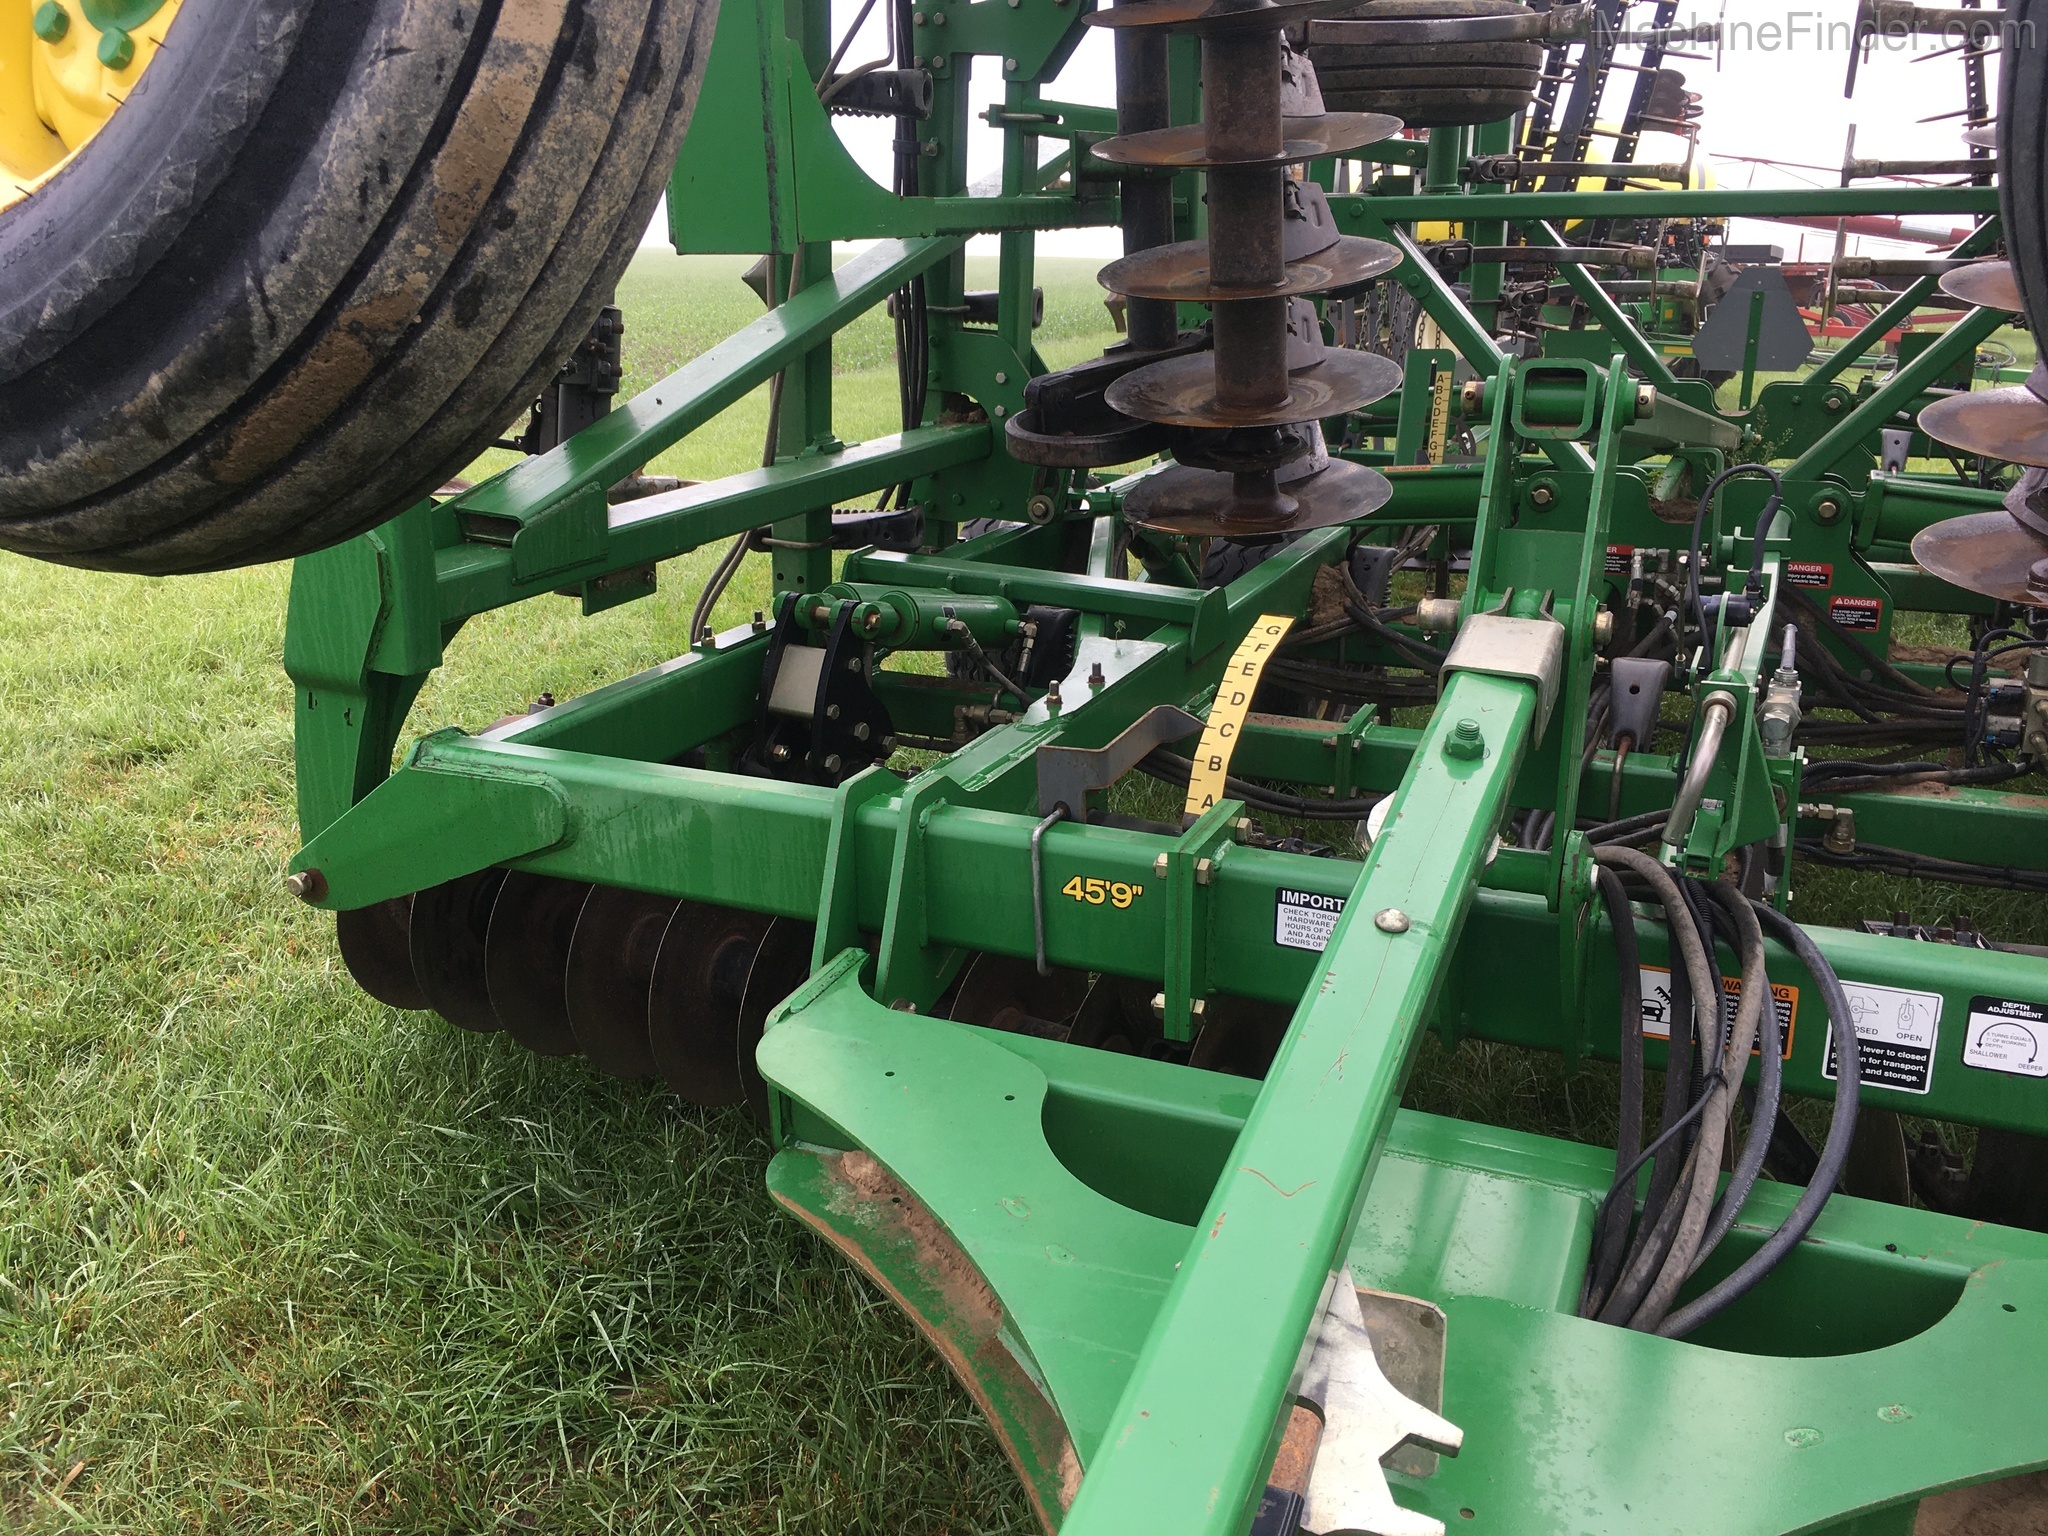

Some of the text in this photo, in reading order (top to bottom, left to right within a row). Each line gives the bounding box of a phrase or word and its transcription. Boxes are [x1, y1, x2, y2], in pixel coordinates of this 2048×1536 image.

[1437, 375, 1444, 383] A
[1436, 386, 1443, 394] B
[1434, 397, 1441, 405] C
[1433, 408, 1440, 417] D
[1432, 419, 1439, 428] E
[1430, 430, 1437, 439] F
[1429, 441, 1438, 451] G
[1429, 452, 1436, 461] H
[1788, 564, 1822, 572] DANGER
[1844, 599, 1877, 607] DANGER
[1266, 625, 1281, 636] G
[1254, 643, 1269, 653] F
[1241, 662, 1257, 677] E
[1230, 691, 1246, 707] D
[1219, 722, 1235, 738] C
[1208, 755, 1222, 772] B
[1201, 794, 1214, 810] A
[1062, 875, 1144, 909] 45'9"
[1282, 890, 1345, 911] IMPORT
[1283, 907, 1309, 917] CHECK
[1287, 915, 1330, 928] HARDWARE
[1284, 922, 1311, 932] HOURS
[1287, 930, 1303, 938] AND
[1283, 936, 1310, 947] HOURS
[2002, 1001, 2030, 1011] DEPTH
[1987, 1006, 2043, 1019] ADJUSTMENT
[1897, 1033, 1923, 1042] OPEN
[1863, 1045, 1927, 1062] lever to closed
[1969, 1049, 2008, 1059] SHALLOWER
[1868, 1057, 1881, 1065] for
[1882, 1059, 1926, 1073] transport,
[2018, 1063, 2043, 1072] DEEPER
[1865, 1067, 1919, 1082] and storage.
